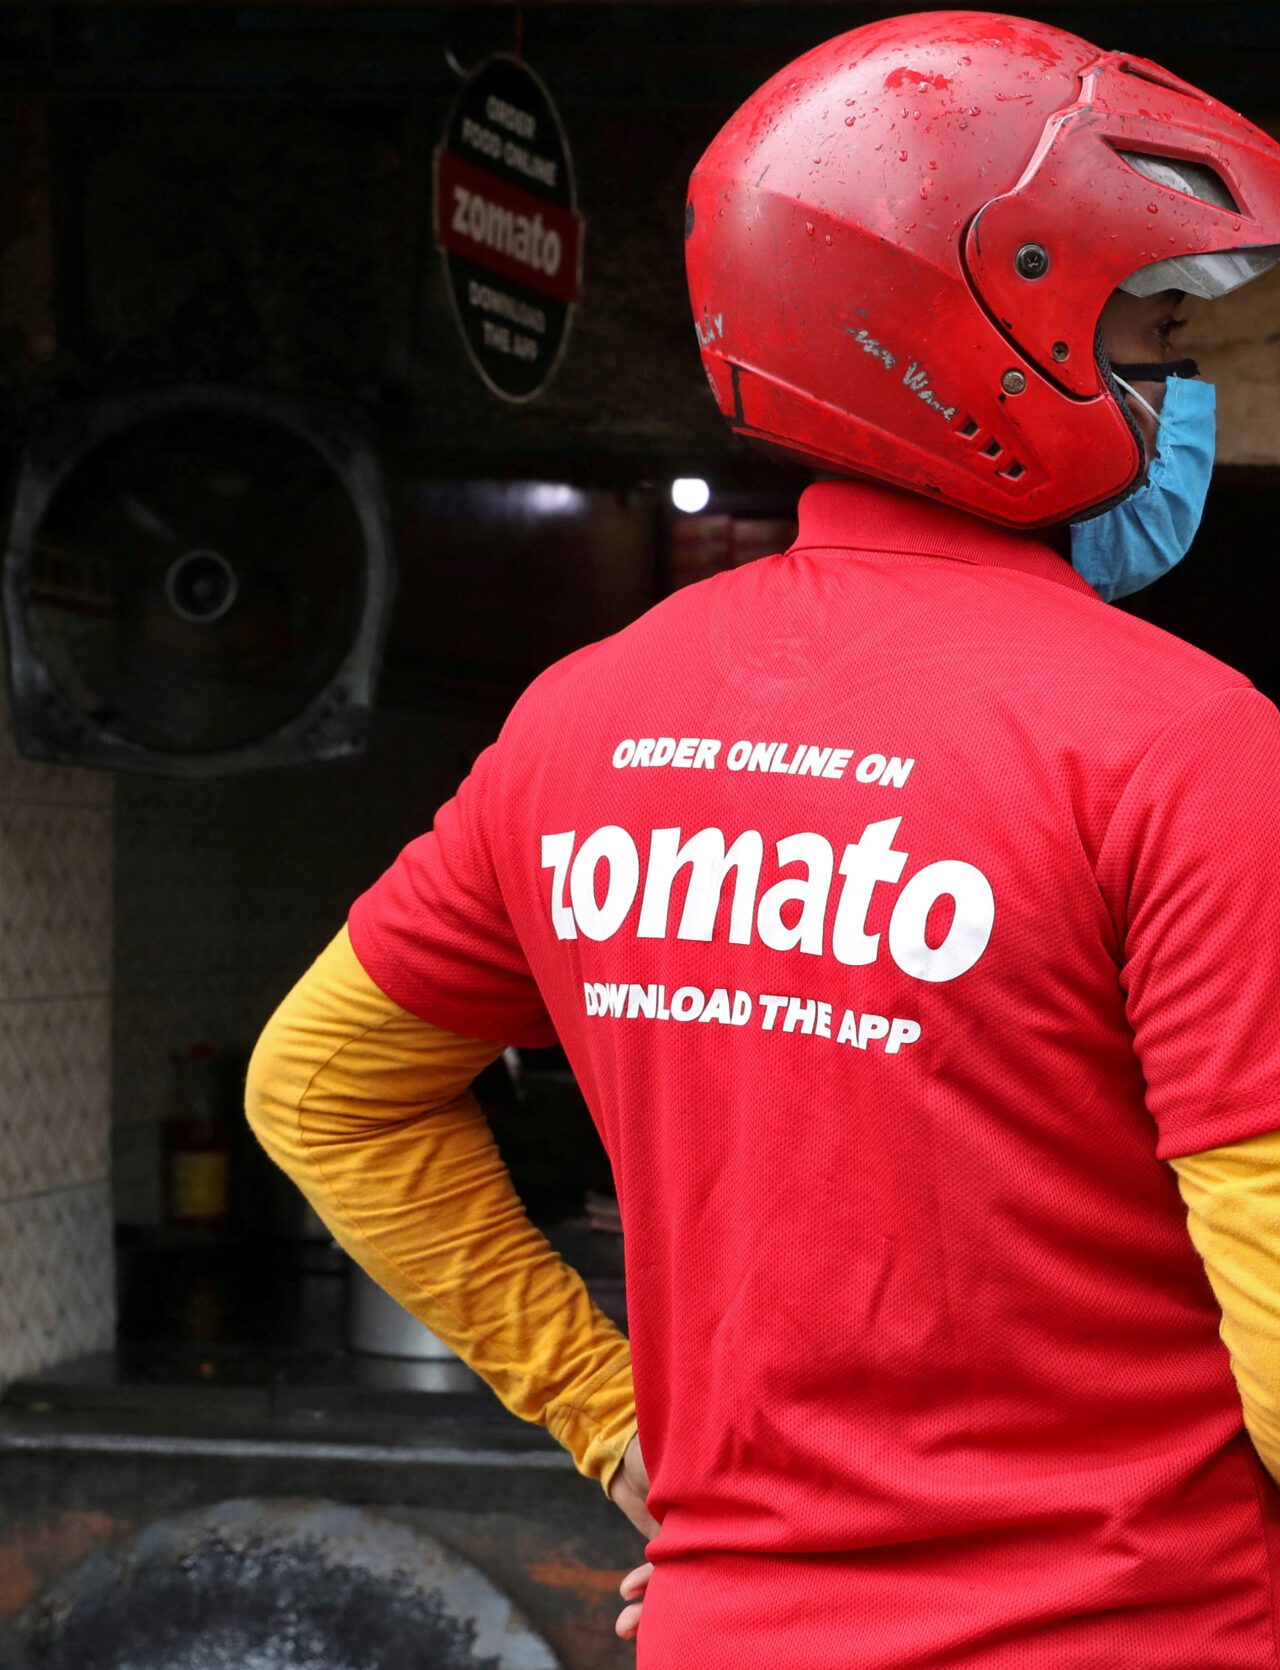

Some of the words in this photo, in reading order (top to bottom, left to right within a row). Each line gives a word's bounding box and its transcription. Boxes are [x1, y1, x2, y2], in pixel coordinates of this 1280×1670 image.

[452, 186, 562, 276] zomato
[611, 736, 722, 770] ORDER
[726, 740, 854, 779] ONLINE
[855, 753, 915, 788] ON
[540, 816, 996, 983] zomato
[583, 982, 752, 1027] DOWNLOAD
[758, 994, 832, 1039] THE
[836, 1012, 922, 1054] APP
